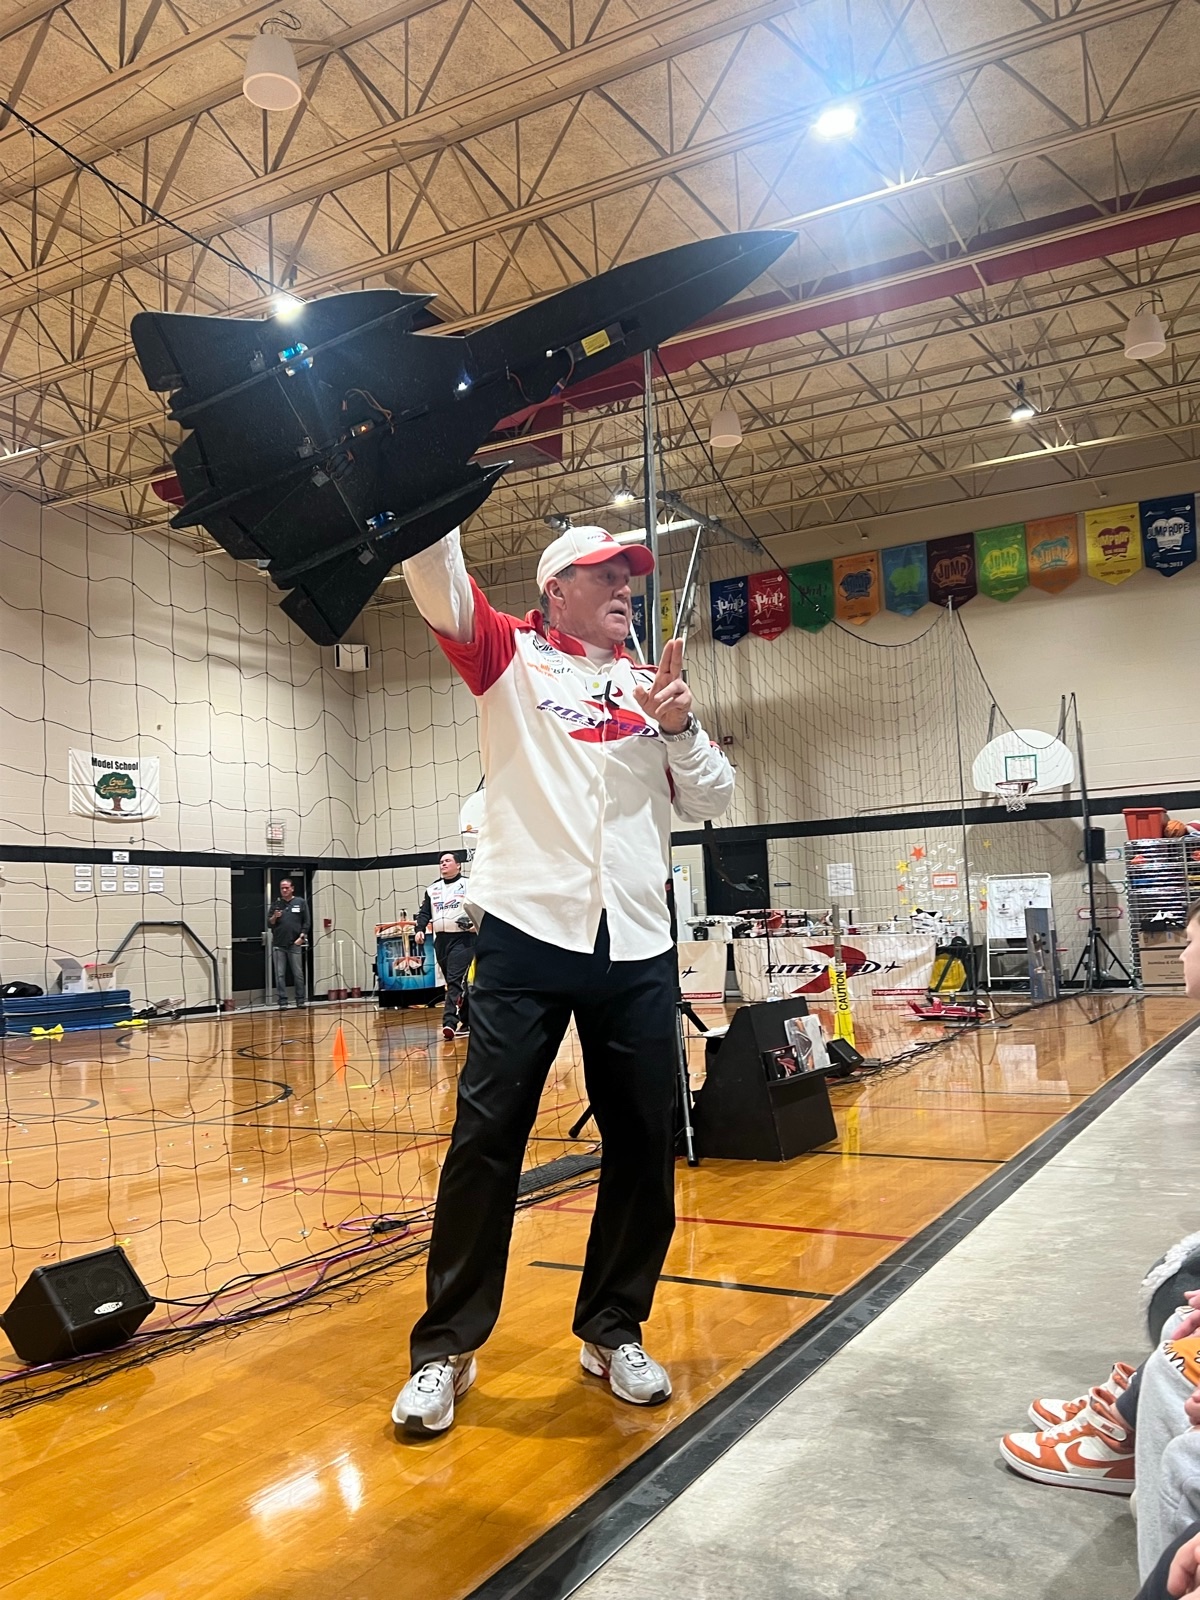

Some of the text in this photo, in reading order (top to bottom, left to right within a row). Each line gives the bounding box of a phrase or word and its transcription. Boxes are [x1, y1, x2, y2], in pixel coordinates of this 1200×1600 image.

[1168, 522, 1190, 536] ROPE
[939, 560, 966, 579] JUMP
[91, 757, 138, 770] Model School
[836, 970, 848, 1011] CAUTION
